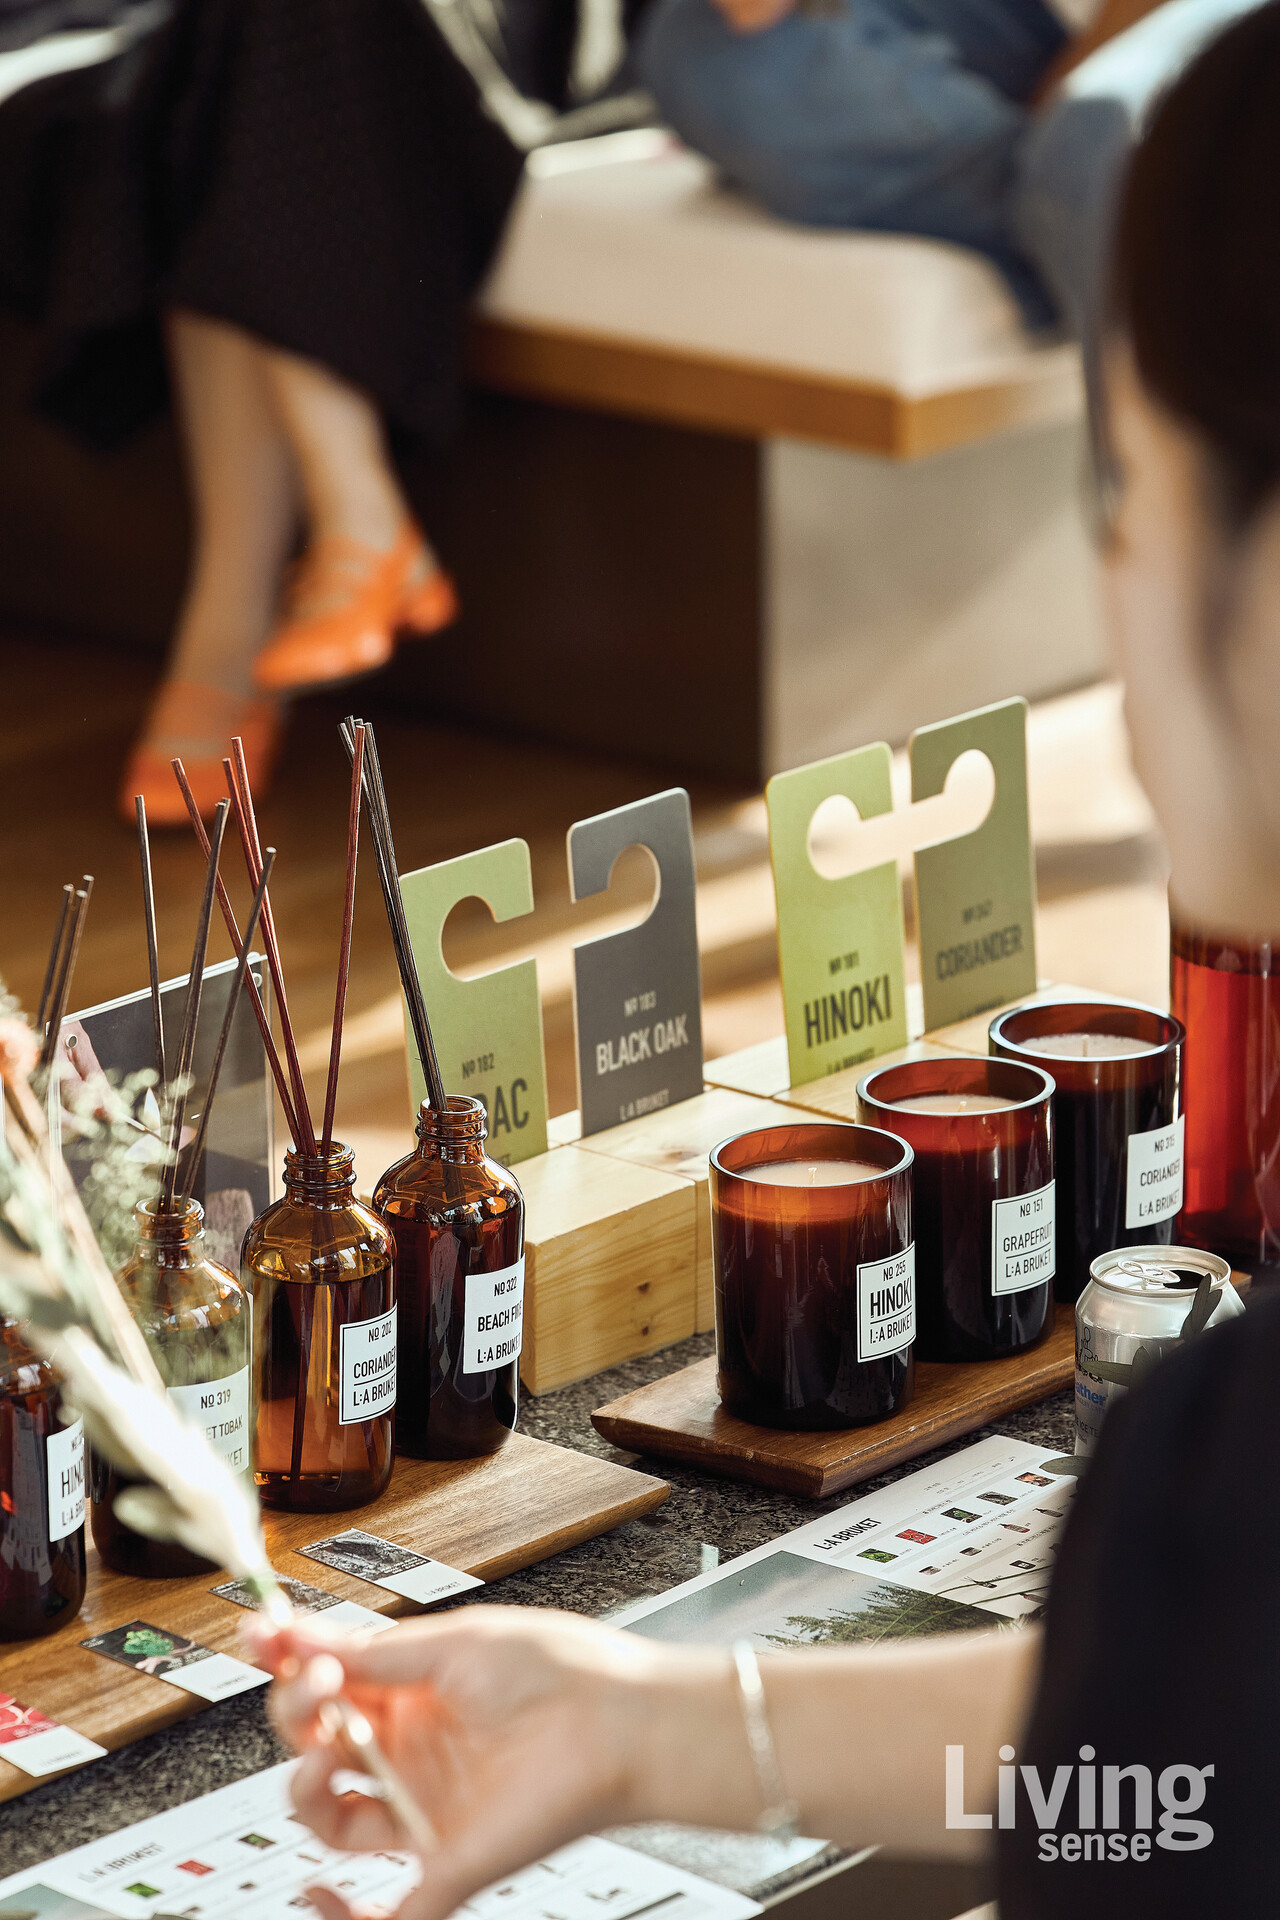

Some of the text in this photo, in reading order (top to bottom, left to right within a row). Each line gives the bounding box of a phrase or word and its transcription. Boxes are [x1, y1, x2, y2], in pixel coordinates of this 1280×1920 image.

[936, 923, 1024, 981] CORIANDER
[804, 974, 892, 1048] HINOKI
[596, 1013, 689, 1075] BLACK OAK
[477, 1052, 495, 1073] 182
[1140, 1158, 1181, 1187] CORIANDER
[1033, 1197, 1044, 1214] 151
[1155, 1188, 1181, 1213] BRUKET
[1003, 1221, 1053, 1253] GRAPEFRUIT
[895, 1259, 907, 1277] 255
[1023, 1248, 1052, 1274] BRUKET
[506, 1276, 518, 1293] 322
[870, 1275, 912, 1319] HINOKI
[381, 1320, 392, 1338] 202
[477, 1308, 510, 1333] BEACH
[887, 1312, 913, 1339] BRUKET
[495, 1332, 521, 1360] BRUKET
[353, 1346, 396, 1379] CORIANDER
[216, 1388, 231, 1406] 319
[372, 1372, 396, 1402] BRUKET
[220, 1414, 243, 1437] TOBAK
[834, 1517, 882, 1542] BRUKET
